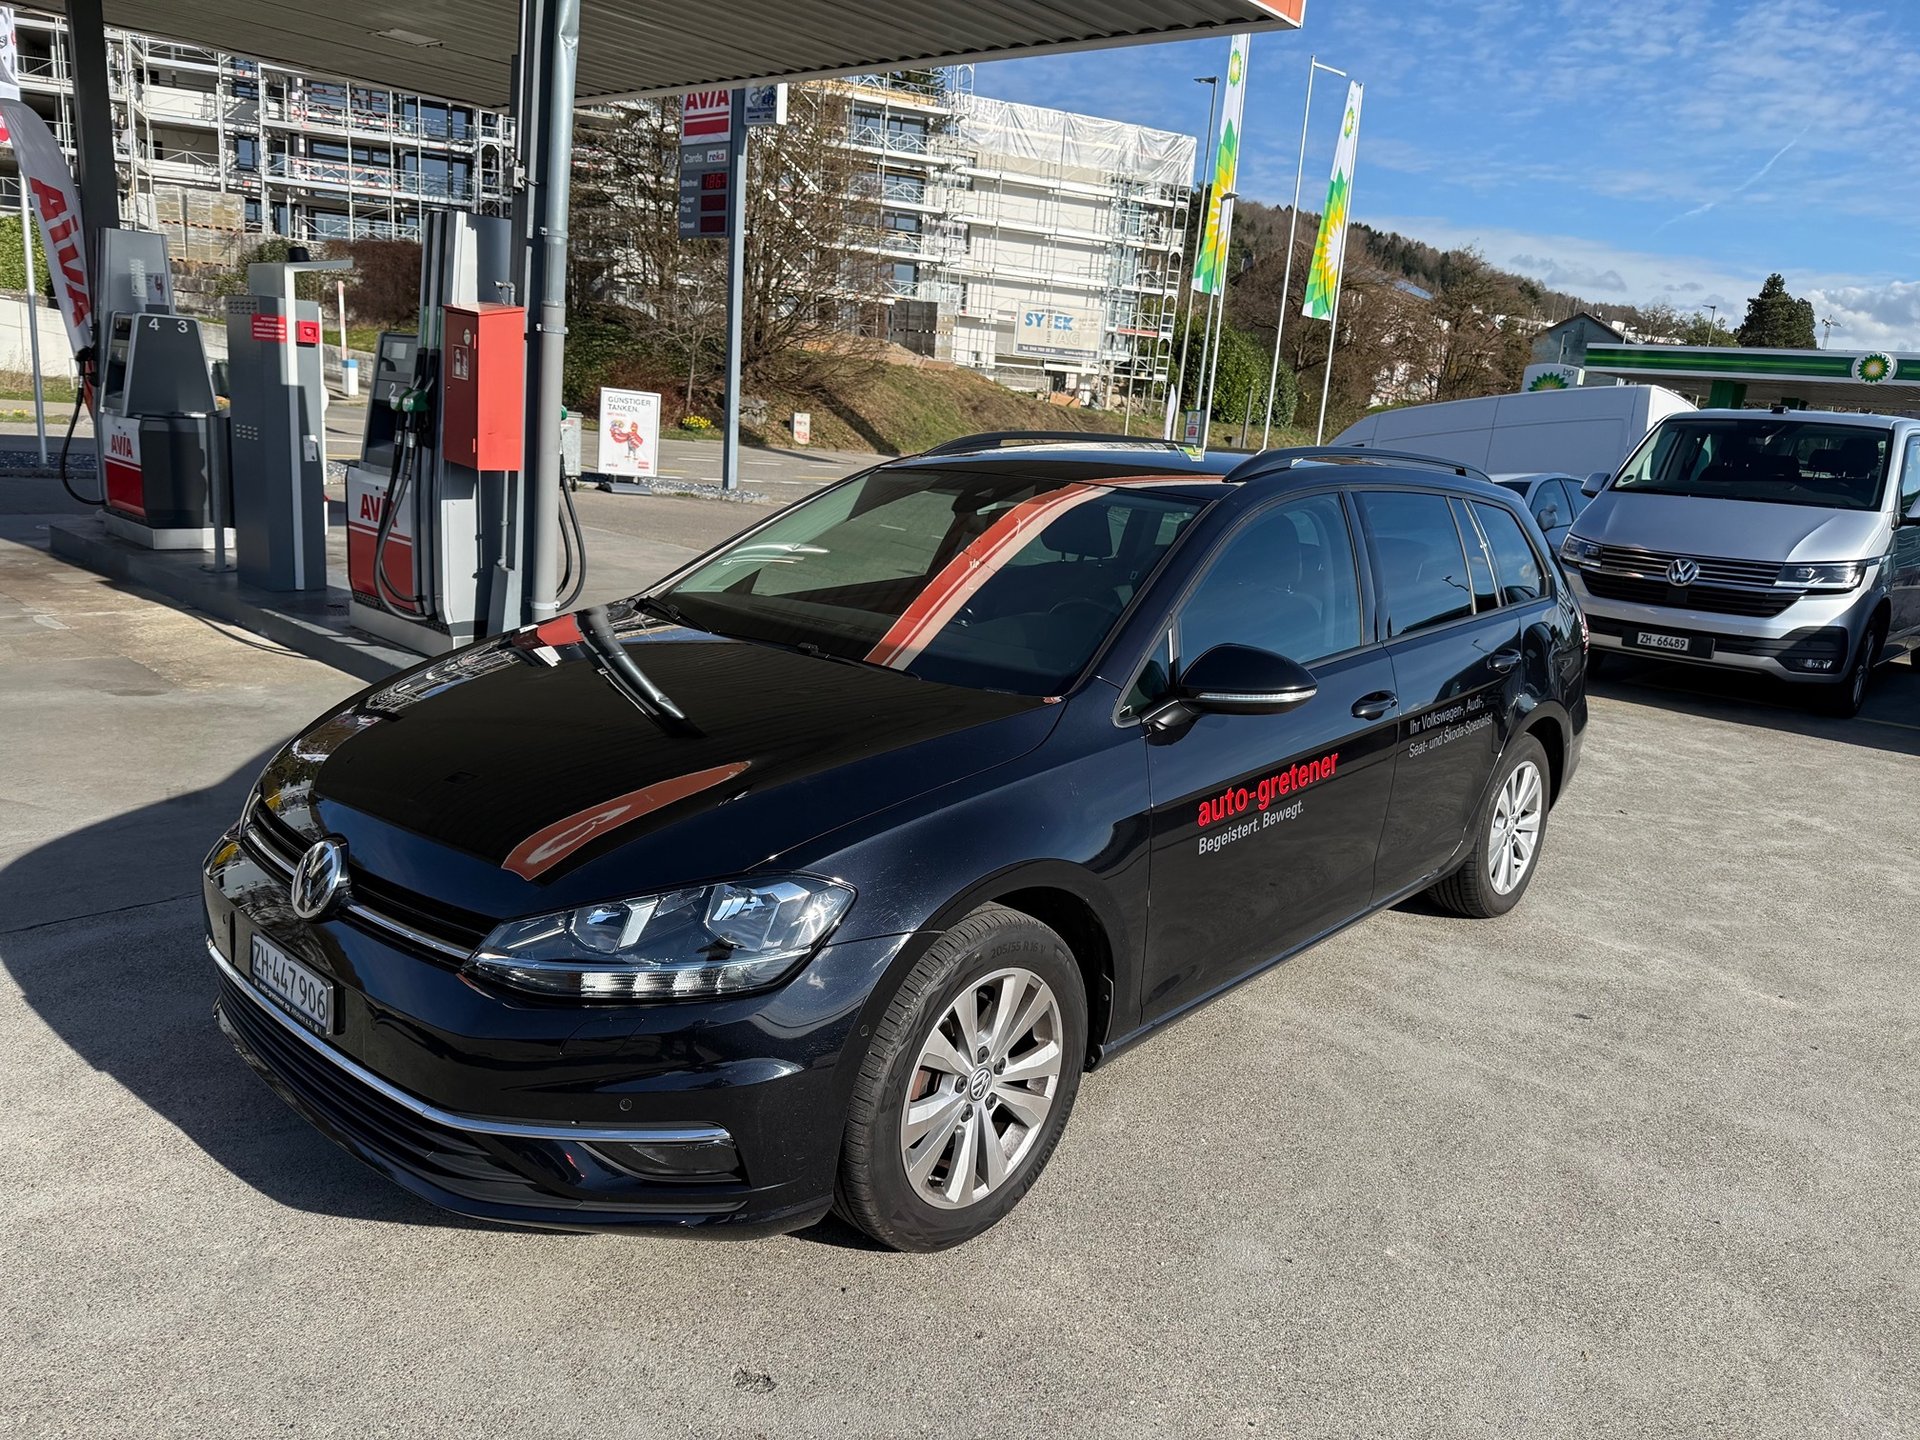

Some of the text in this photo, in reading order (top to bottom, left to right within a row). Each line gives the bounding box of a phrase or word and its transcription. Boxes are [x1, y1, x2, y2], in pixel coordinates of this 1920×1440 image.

[685, 90, 729, 111] AVIA
[683, 153, 703, 164] Cards
[148, 318, 189, 333] 4 3
[1562, 367, 1575, 378] bp
[388, 382, 399, 398] 2
[607, 395, 651, 407] GÜNSTIGER
[111, 432, 133, 459] AVIA
[360, 491, 398, 528] AV
[1409, 719, 1421, 735] Ihr
[1421, 705, 1466, 731] Volkswagen-,
[1408, 741, 1428, 758] Seat-
[1428, 731, 1443, 750] und
[1197, 752, 1339, 827] auto-gretener
[1198, 799, 1304, 856] Begeistert. Bewegt.
